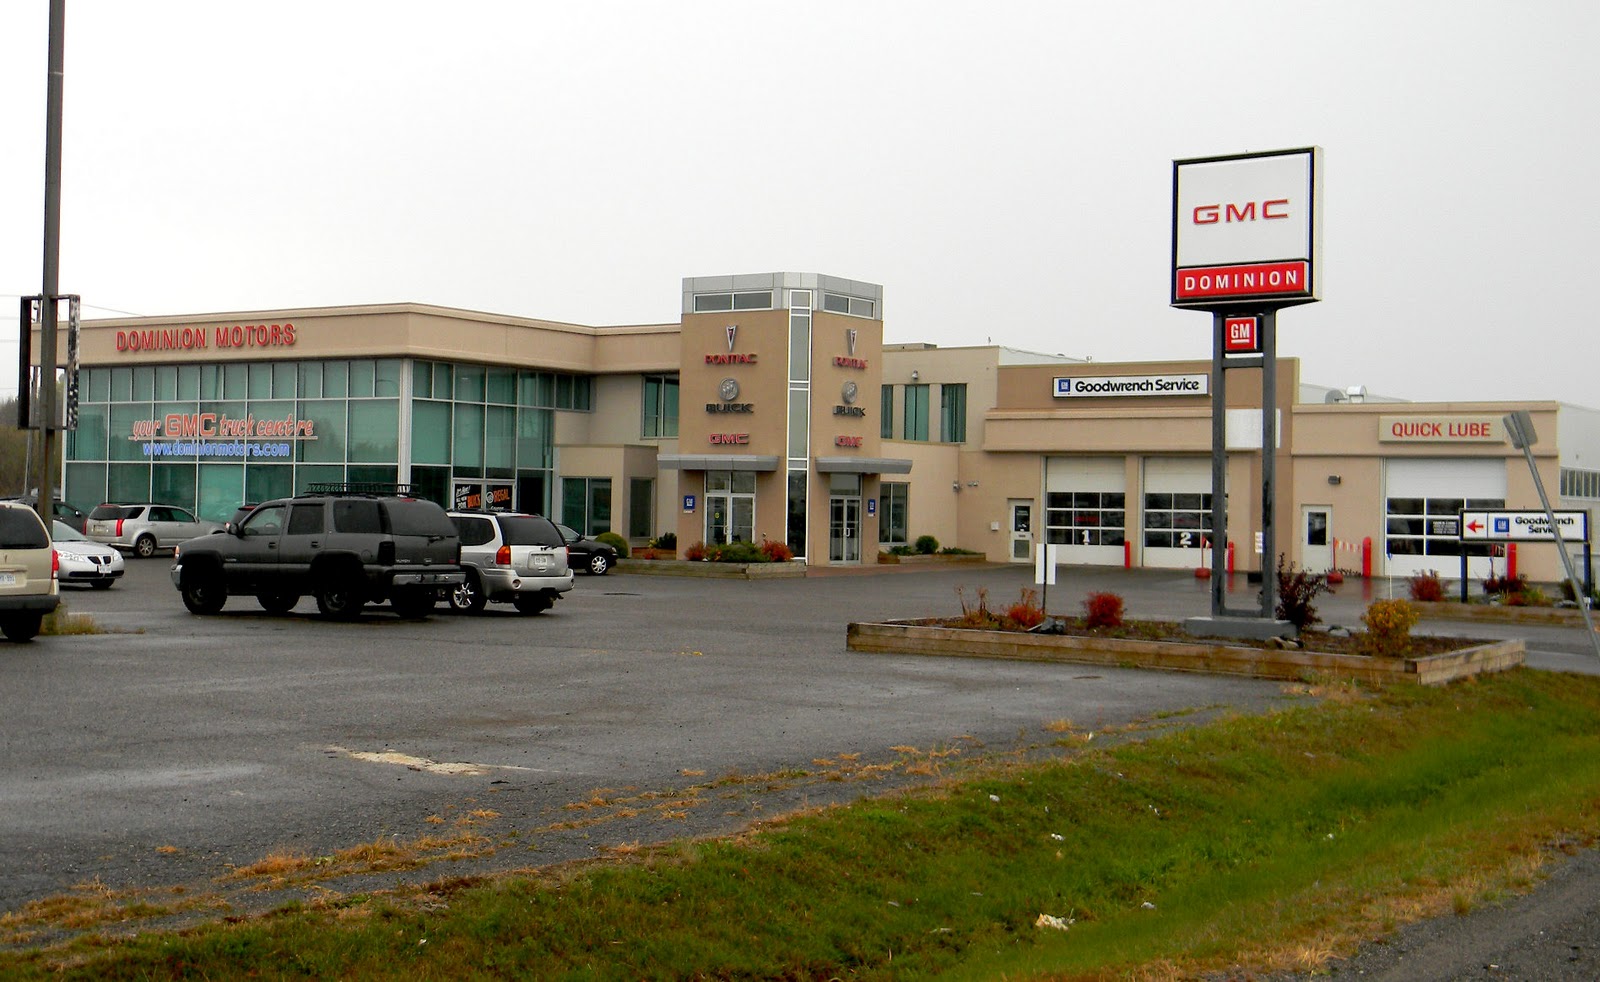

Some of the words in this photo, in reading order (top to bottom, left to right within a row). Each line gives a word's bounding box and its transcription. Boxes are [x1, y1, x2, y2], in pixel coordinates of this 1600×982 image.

[1193, 199, 1289, 225] GMC
[1184, 270, 1297, 291] DOMINION
[116, 328, 206, 351] DOMINION
[216, 324, 295, 348] MOTORS
[1231, 323, 1250, 339] GM
[704, 354, 757, 365] PONTIAC
[1075, 380, 1153, 393] Goodwrench
[1155, 378, 1199, 391] Service
[706, 403, 754, 413] BUICK
[834, 406, 866, 417] BUICK
[133, 419, 161, 441] your
[165, 413, 217, 437] GMC
[220, 414, 254, 437] truck
[256, 414, 314, 437] centre
[1392, 422, 1442, 437] QUICK
[1449, 422, 1491, 437] LUBE
[709, 433, 749, 445] GMC
[836, 435, 863, 447] GMC
[143, 439, 290, 457] www.dominionmotors.com
[1515, 516, 1574, 525] Goodwnch
[1082, 530, 1090, 543] 1
[1181, 532, 1191, 545] 2
